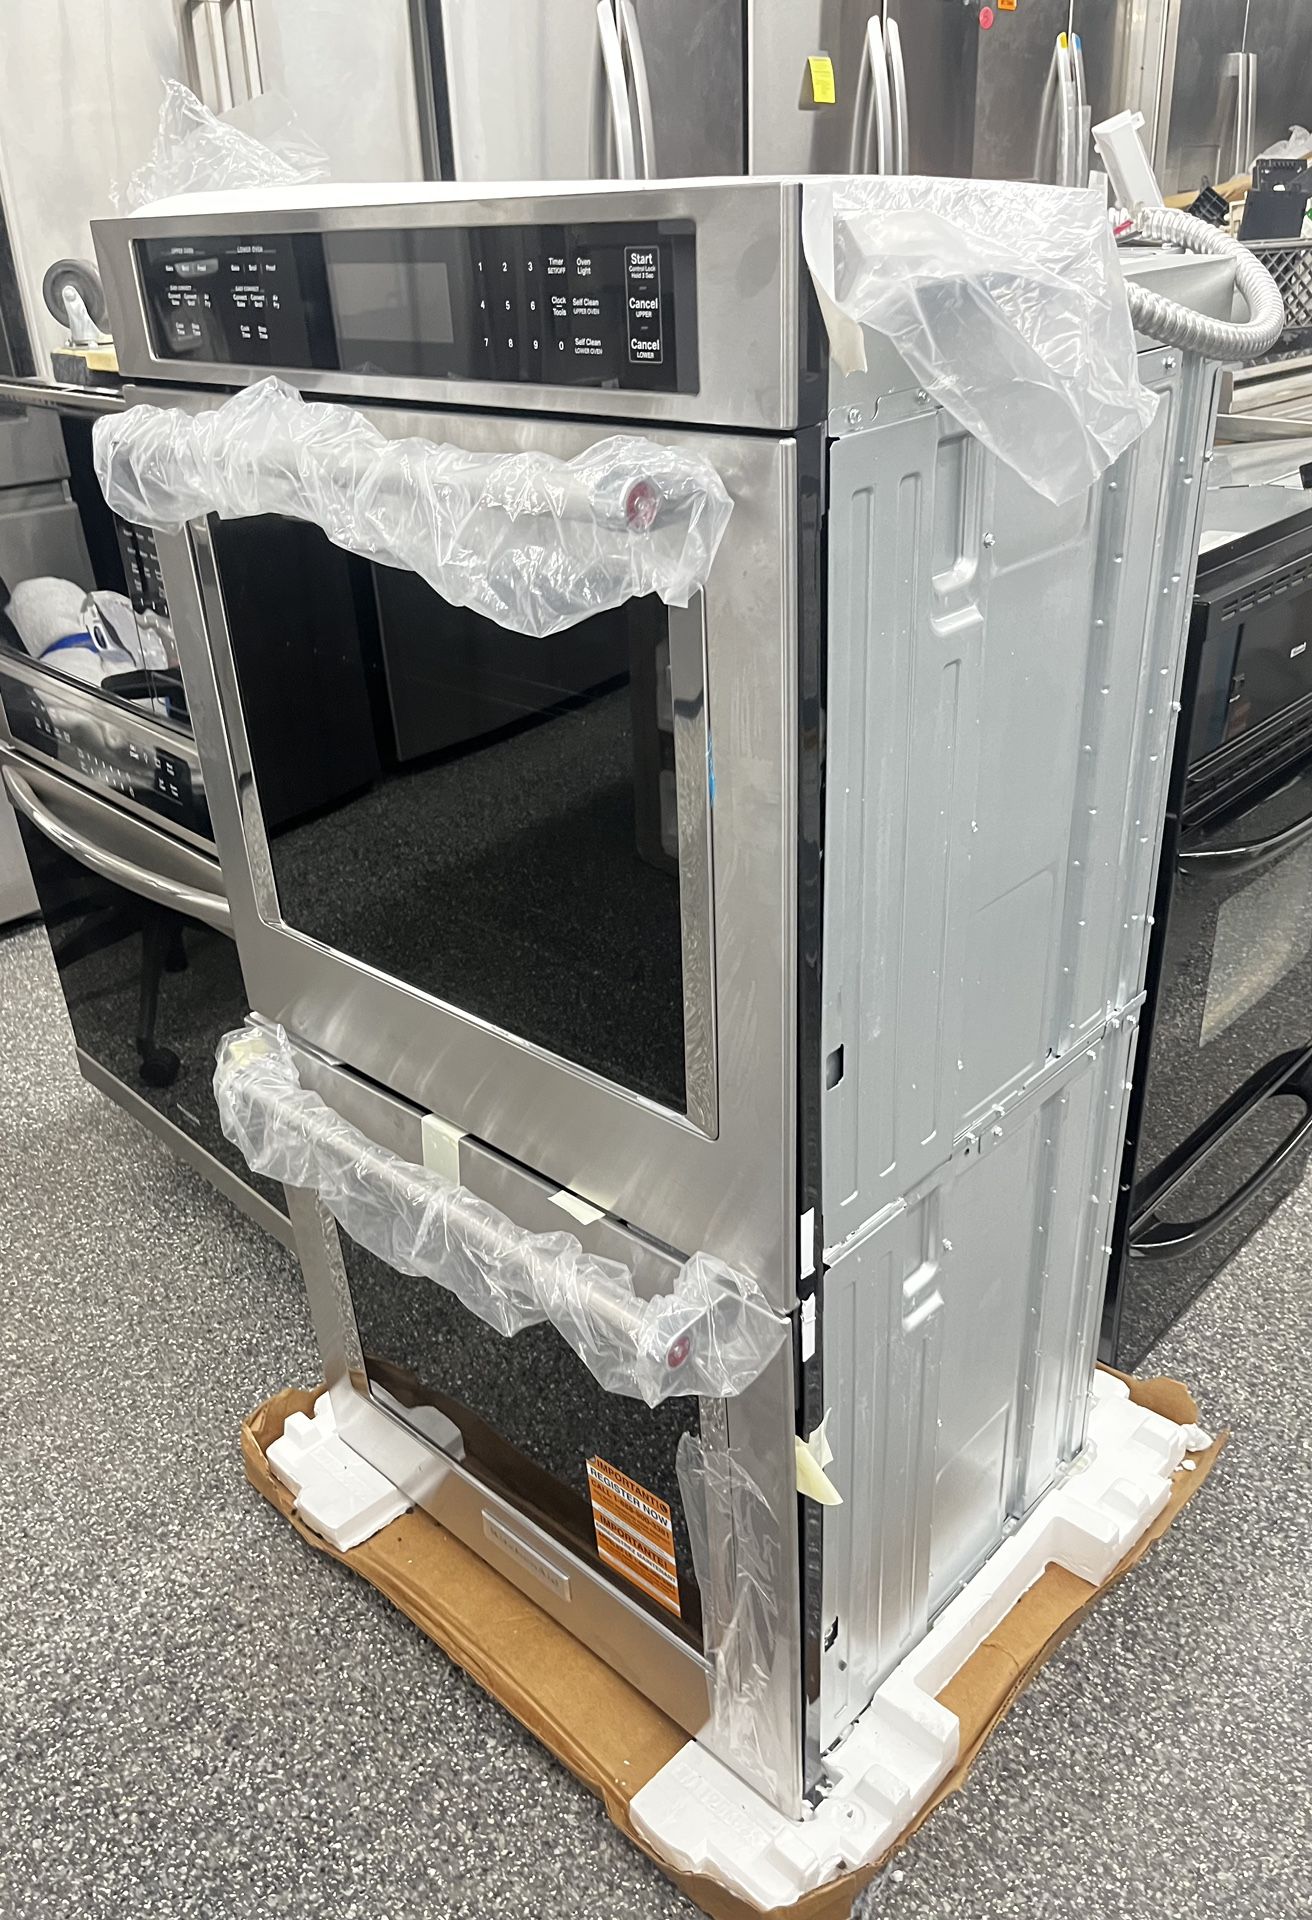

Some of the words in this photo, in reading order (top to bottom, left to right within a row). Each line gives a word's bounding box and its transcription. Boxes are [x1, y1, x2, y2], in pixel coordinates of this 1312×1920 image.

[548, 258, 564, 266] Timer
[576, 258, 591, 266] Oven
[631, 253, 653, 264] Start
[478, 262, 483, 271] 1
[502, 262, 508, 272] 2
[527, 261, 533, 271] 3
[577, 267, 592, 276] Light
[551, 296, 567, 304] Clock
[572, 298, 583, 306] Self
[584, 298, 600, 306] Clean
[629, 298, 659, 309] Cancel
[480, 301, 485, 310] 4
[505, 301, 510, 310] 5
[530, 301, 536, 310] 6
[553, 308, 567, 316] Tools
[484, 338, 488, 347] 7
[508, 338, 513, 348] 8
[534, 340, 539, 350] 9
[559, 341, 564, 351] 0
[575, 338, 585, 346] Self
[586, 338, 602, 346] Clean
[631, 338, 660, 350] Cancel
[590, 347, 603, 355] OVEN
[590, 1467, 640, 1508] REGISTER
[643, 1504, 668, 1527] NOW
